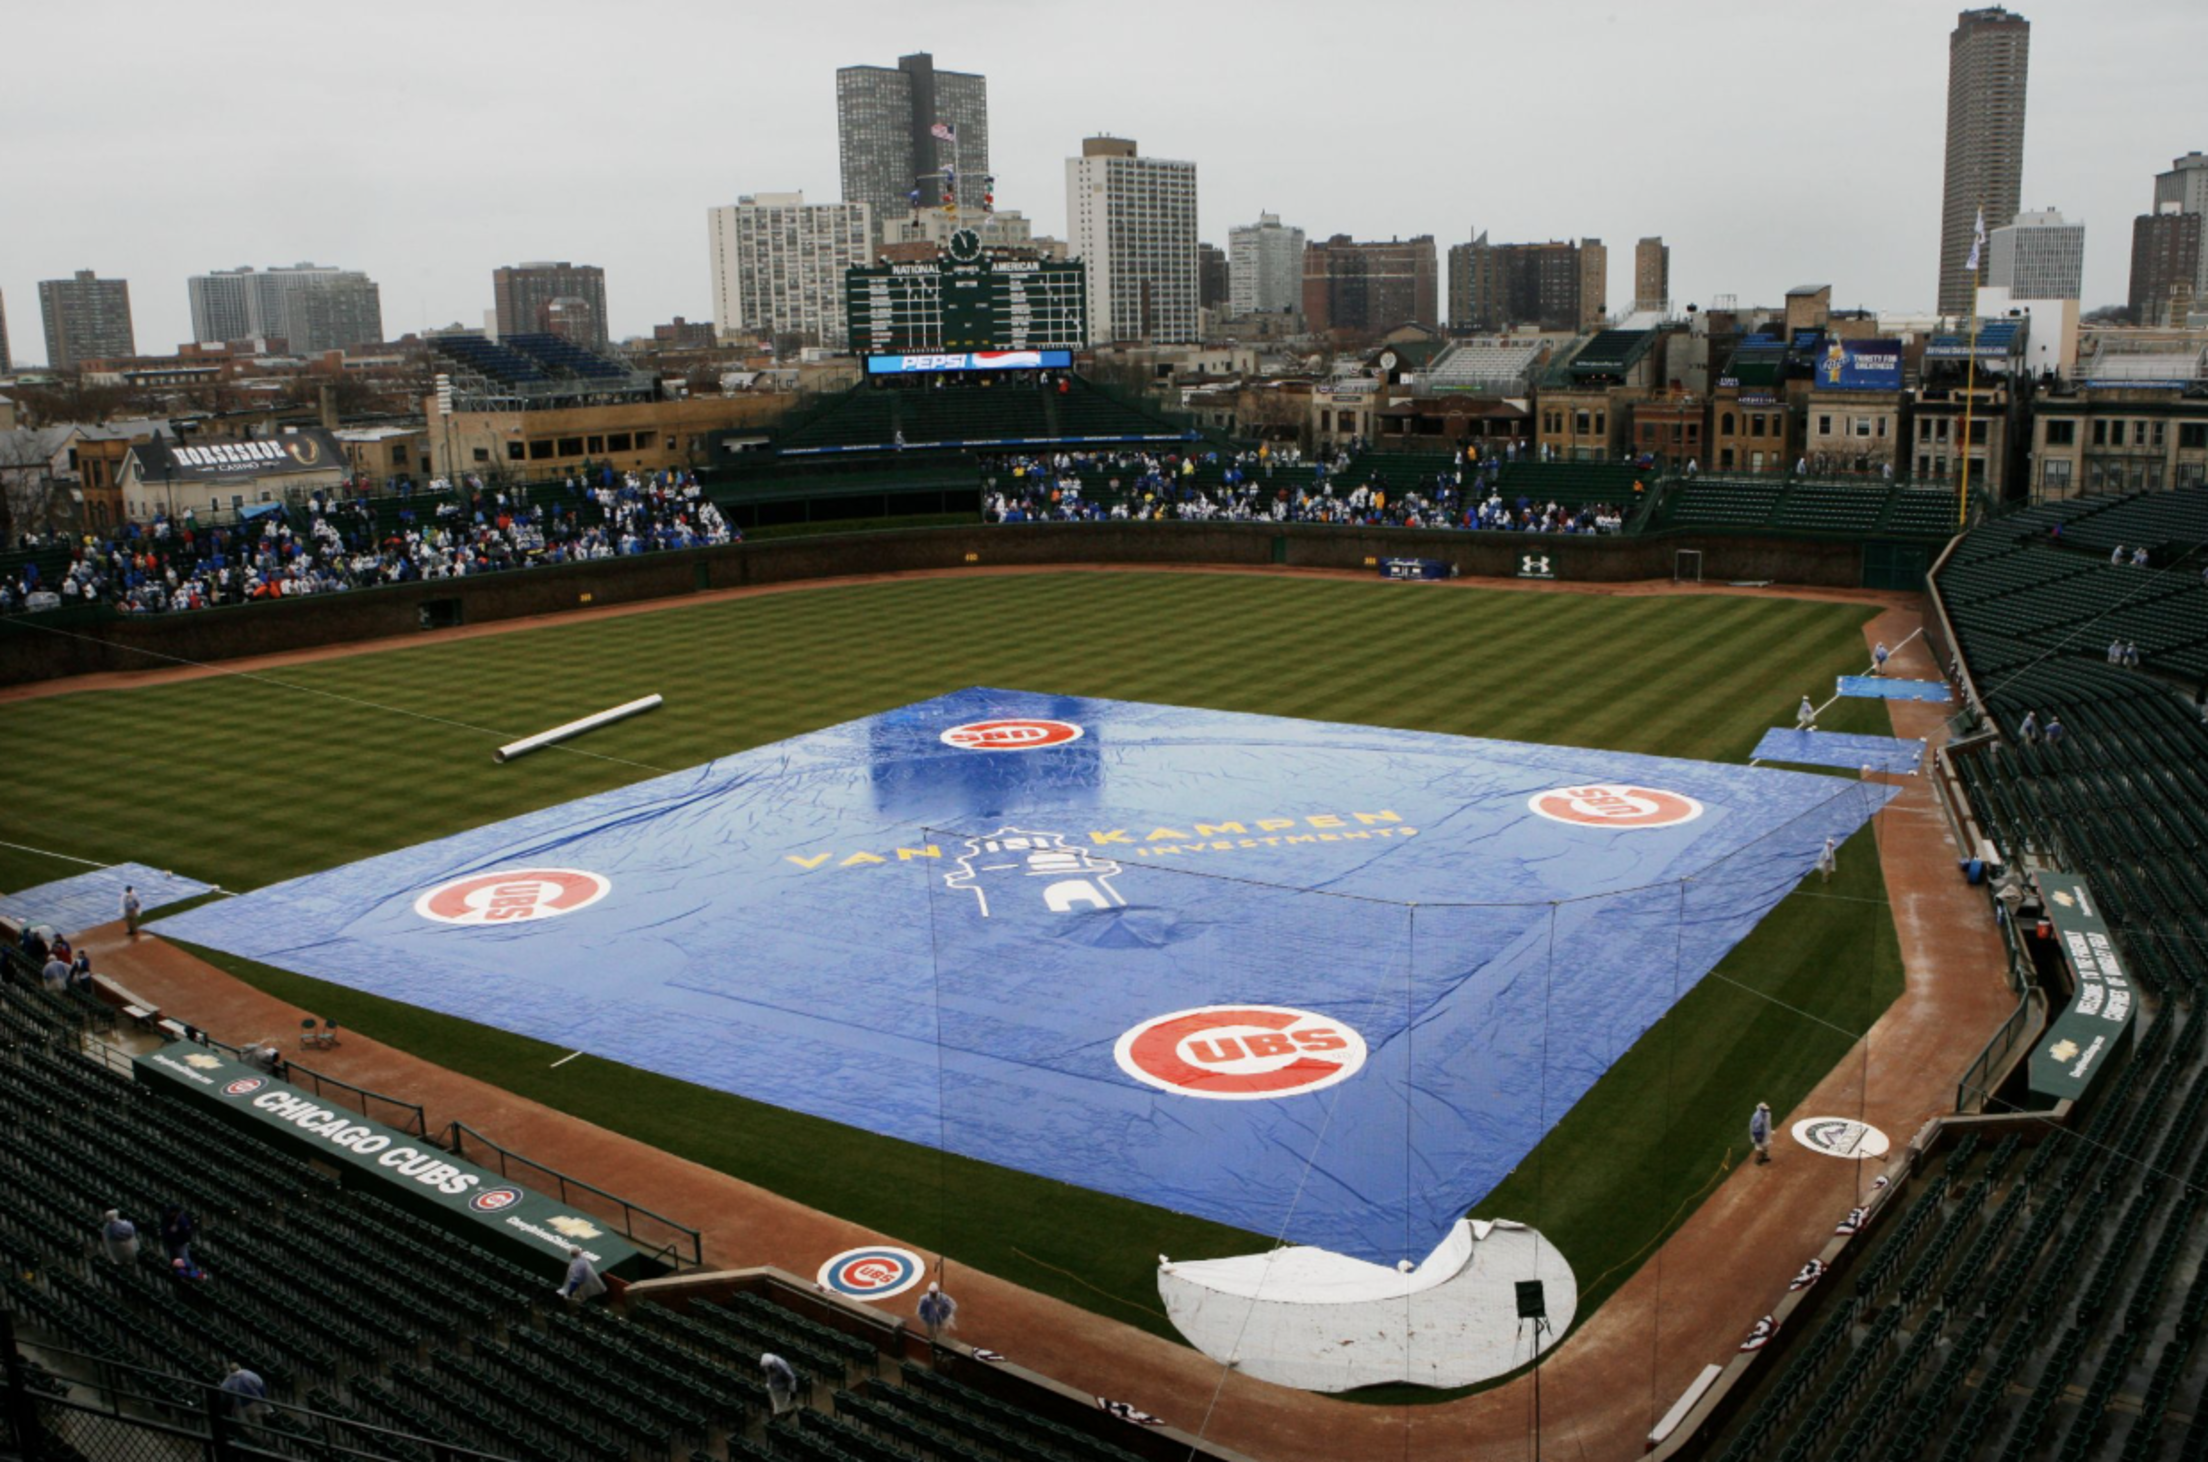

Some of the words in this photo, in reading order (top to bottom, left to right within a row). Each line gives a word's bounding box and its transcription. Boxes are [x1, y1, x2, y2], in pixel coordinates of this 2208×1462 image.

[892, 263, 942, 274] NATIONAL
[991, 261, 1040, 272] AMERICAN
[902, 354, 968, 371] PEPSI
[171, 440, 288, 466] HORSESHOE
[218, 461, 260, 472] CASINO
[784, 844, 942, 870] VAN
[1088, 809, 1403, 845] KAMPEN
[1136, 826, 1420, 857] INVESTMENTS
[253, 1091, 391, 1154] CHICAGO
[378, 1147, 480, 1194] CUBS
[843, 1258, 899, 1288] CUBS
